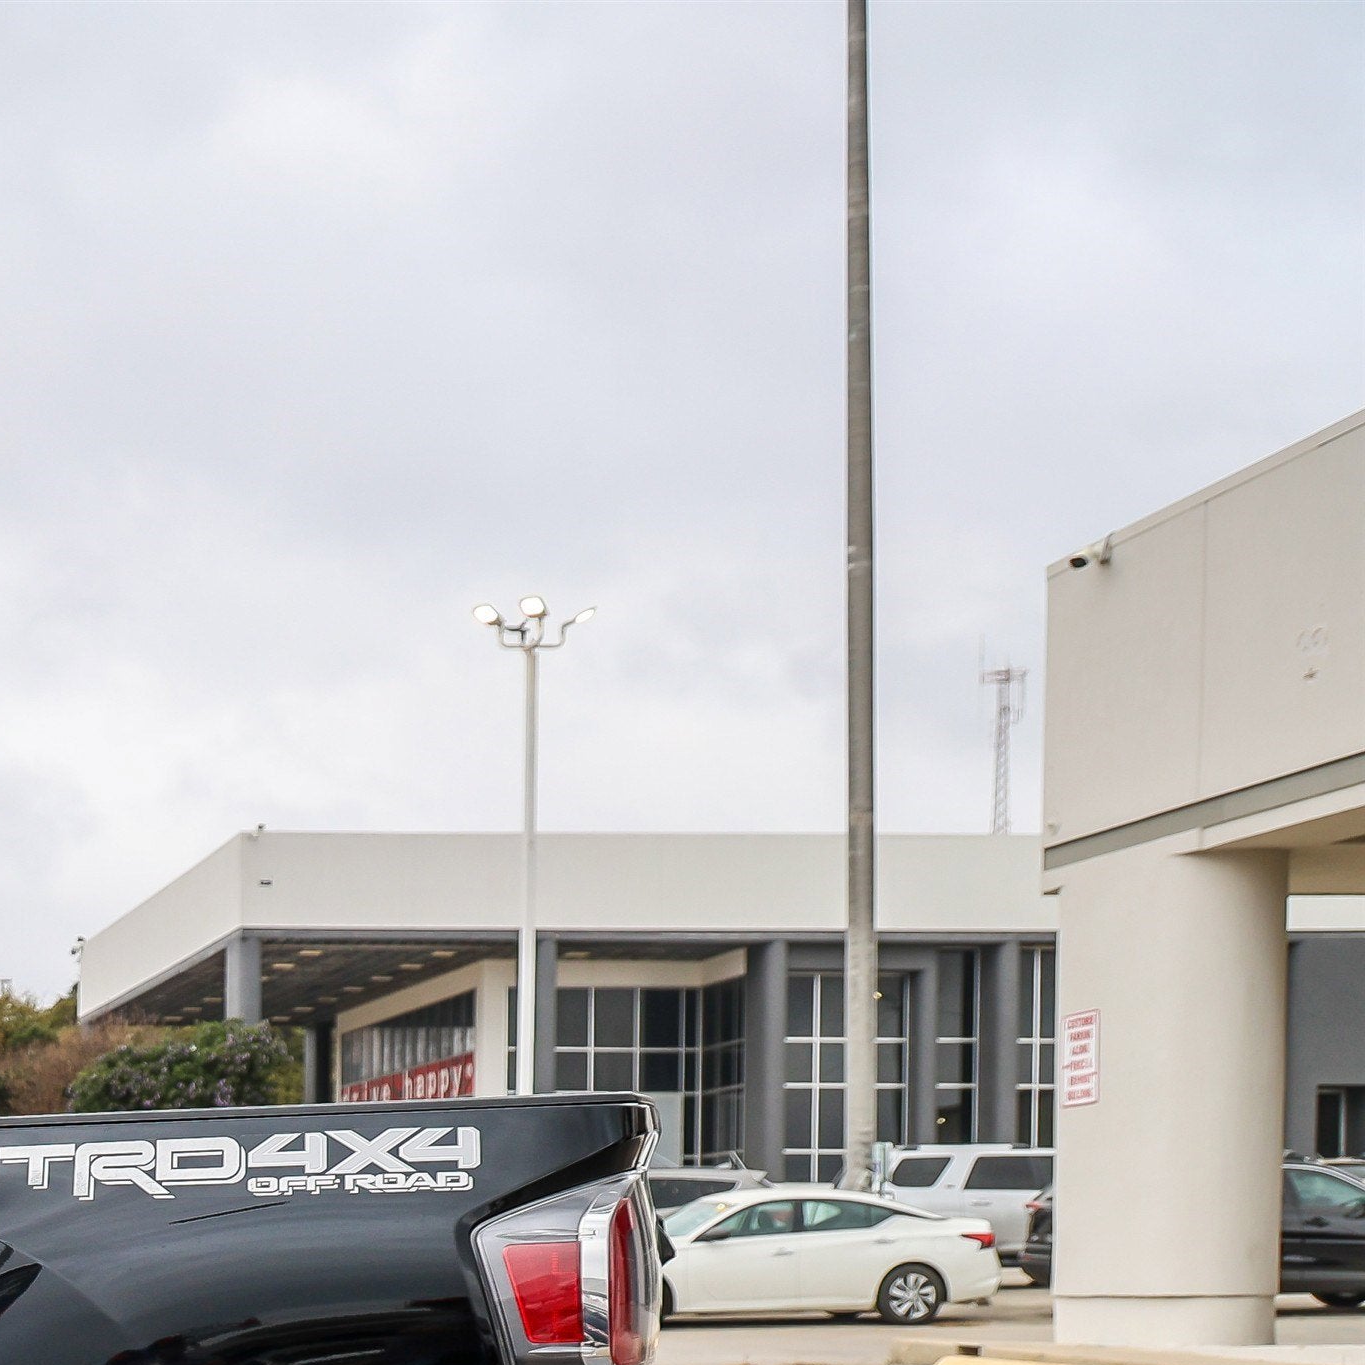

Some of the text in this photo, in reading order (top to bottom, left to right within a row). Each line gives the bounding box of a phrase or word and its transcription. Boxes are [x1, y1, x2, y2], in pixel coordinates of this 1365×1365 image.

[247, 1126, 482, 1174] 4X4
[247, 1169, 474, 1195] OFF ROAD
